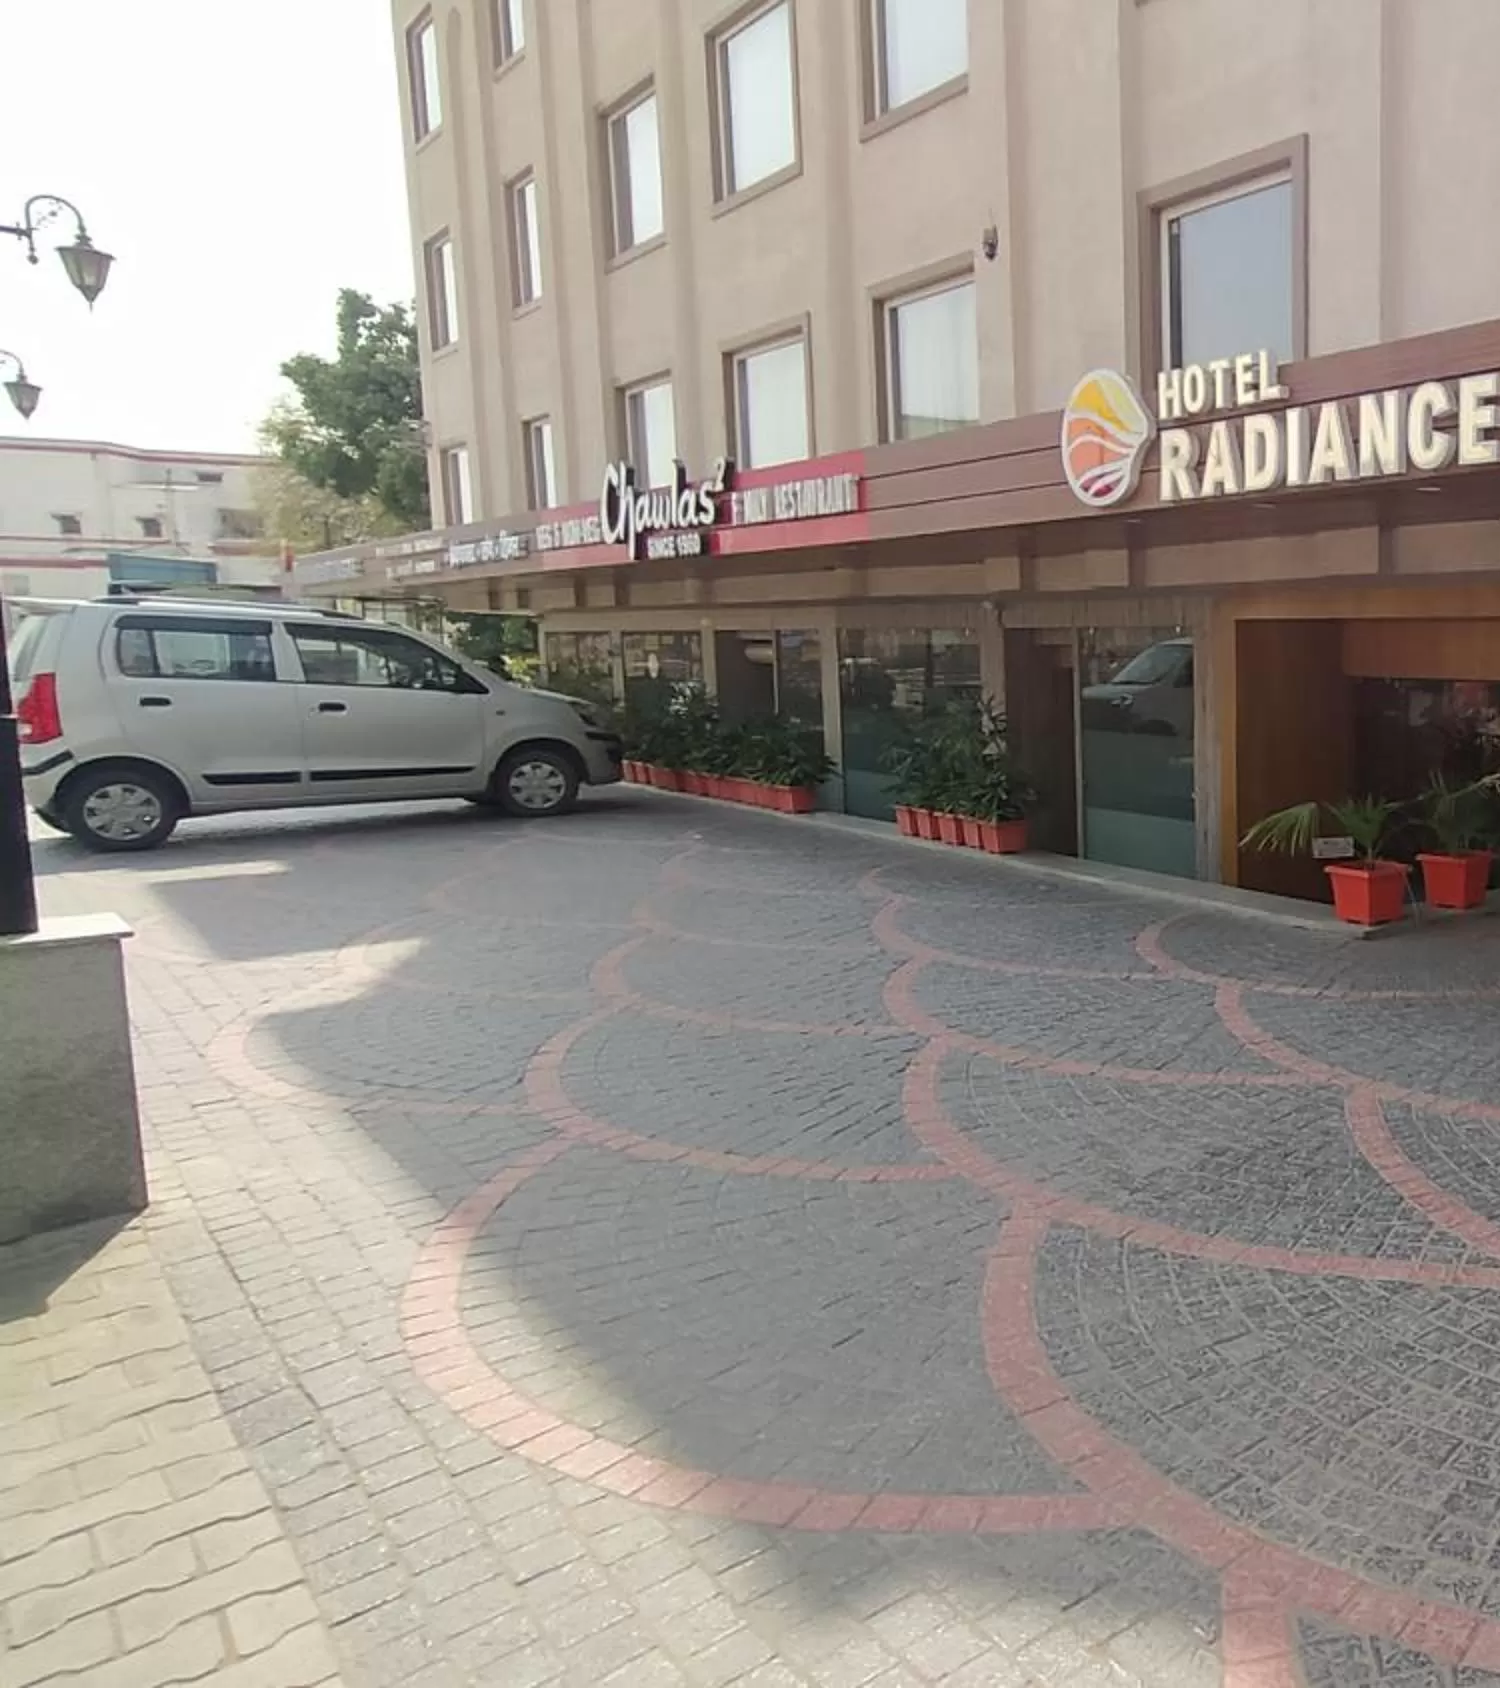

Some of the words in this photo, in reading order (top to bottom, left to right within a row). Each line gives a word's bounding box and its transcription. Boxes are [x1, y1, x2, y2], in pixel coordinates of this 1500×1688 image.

[1157, 348, 1286, 421] HOTEL
[773, 472, 860, 520] RESTAURANT
[647, 533, 676, 561] SINCE
